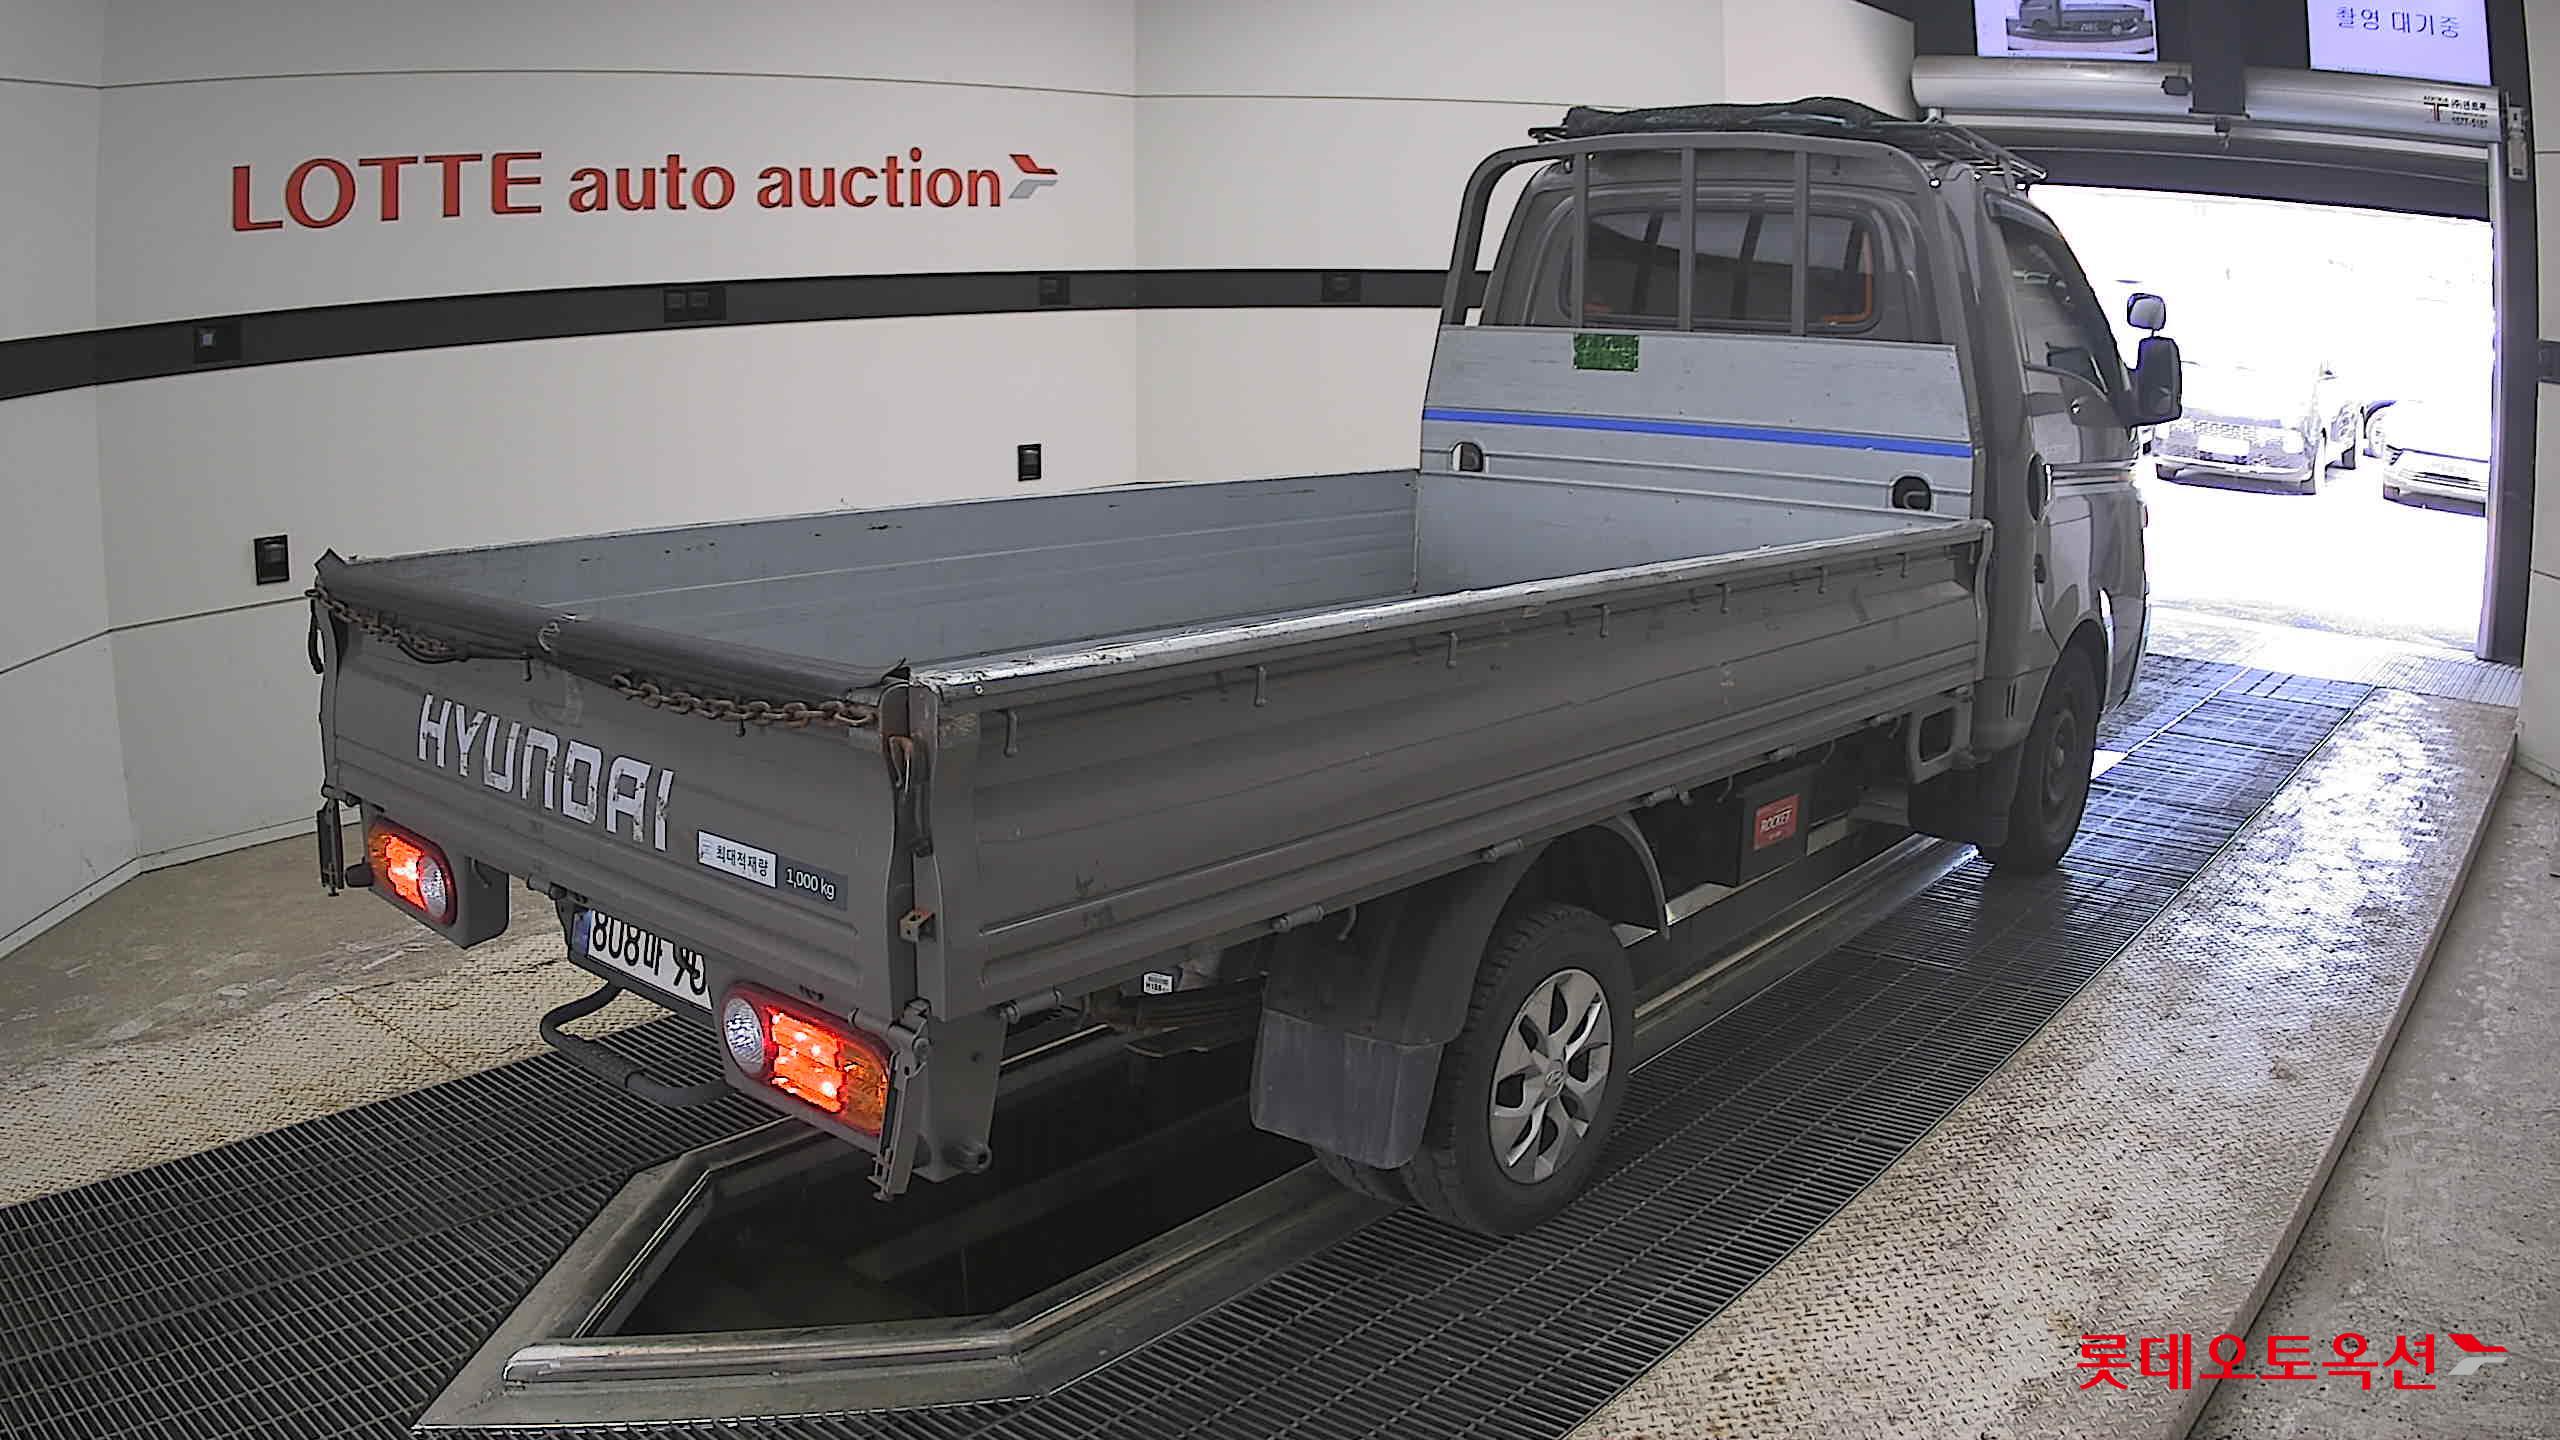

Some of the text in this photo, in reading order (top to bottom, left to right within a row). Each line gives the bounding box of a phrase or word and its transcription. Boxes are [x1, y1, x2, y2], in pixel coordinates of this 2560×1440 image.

[2391, 11, 2459, 39] 대기중
[231, 147, 1001, 232] LOTTE auto auction
[417, 693, 675, 852] HYUNDAI
[716, 844, 769, 877] 최대적재량
[786, 867, 836, 901] 1,000 kg
